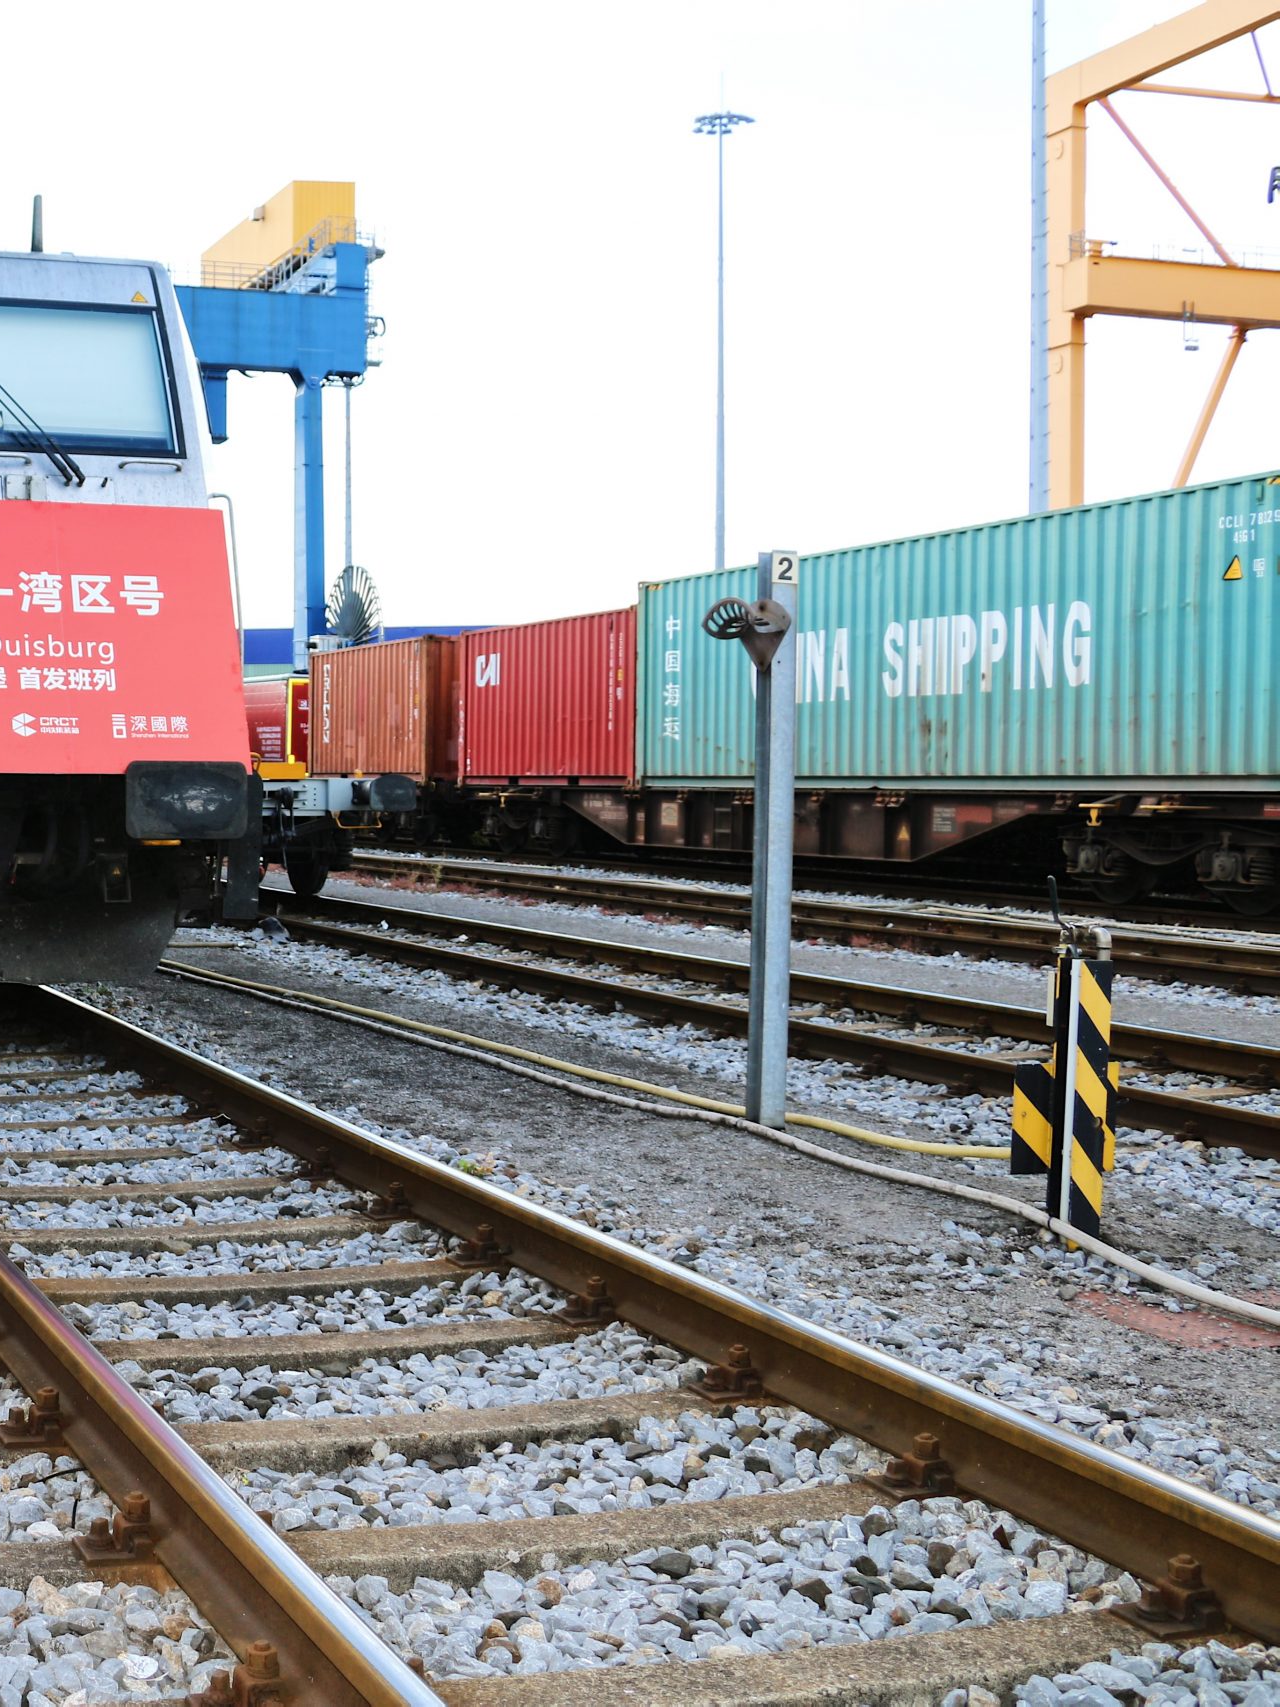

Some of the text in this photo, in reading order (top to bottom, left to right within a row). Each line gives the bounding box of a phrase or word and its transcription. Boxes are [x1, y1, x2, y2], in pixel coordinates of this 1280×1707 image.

[778, 557, 793, 581] 2
[881, 600, 1092, 698] SHIPPING
[17, 666, 117, 691] 首发班列
[39, 716, 79, 726] CRCT
[130, 715, 189, 732] 深國際
